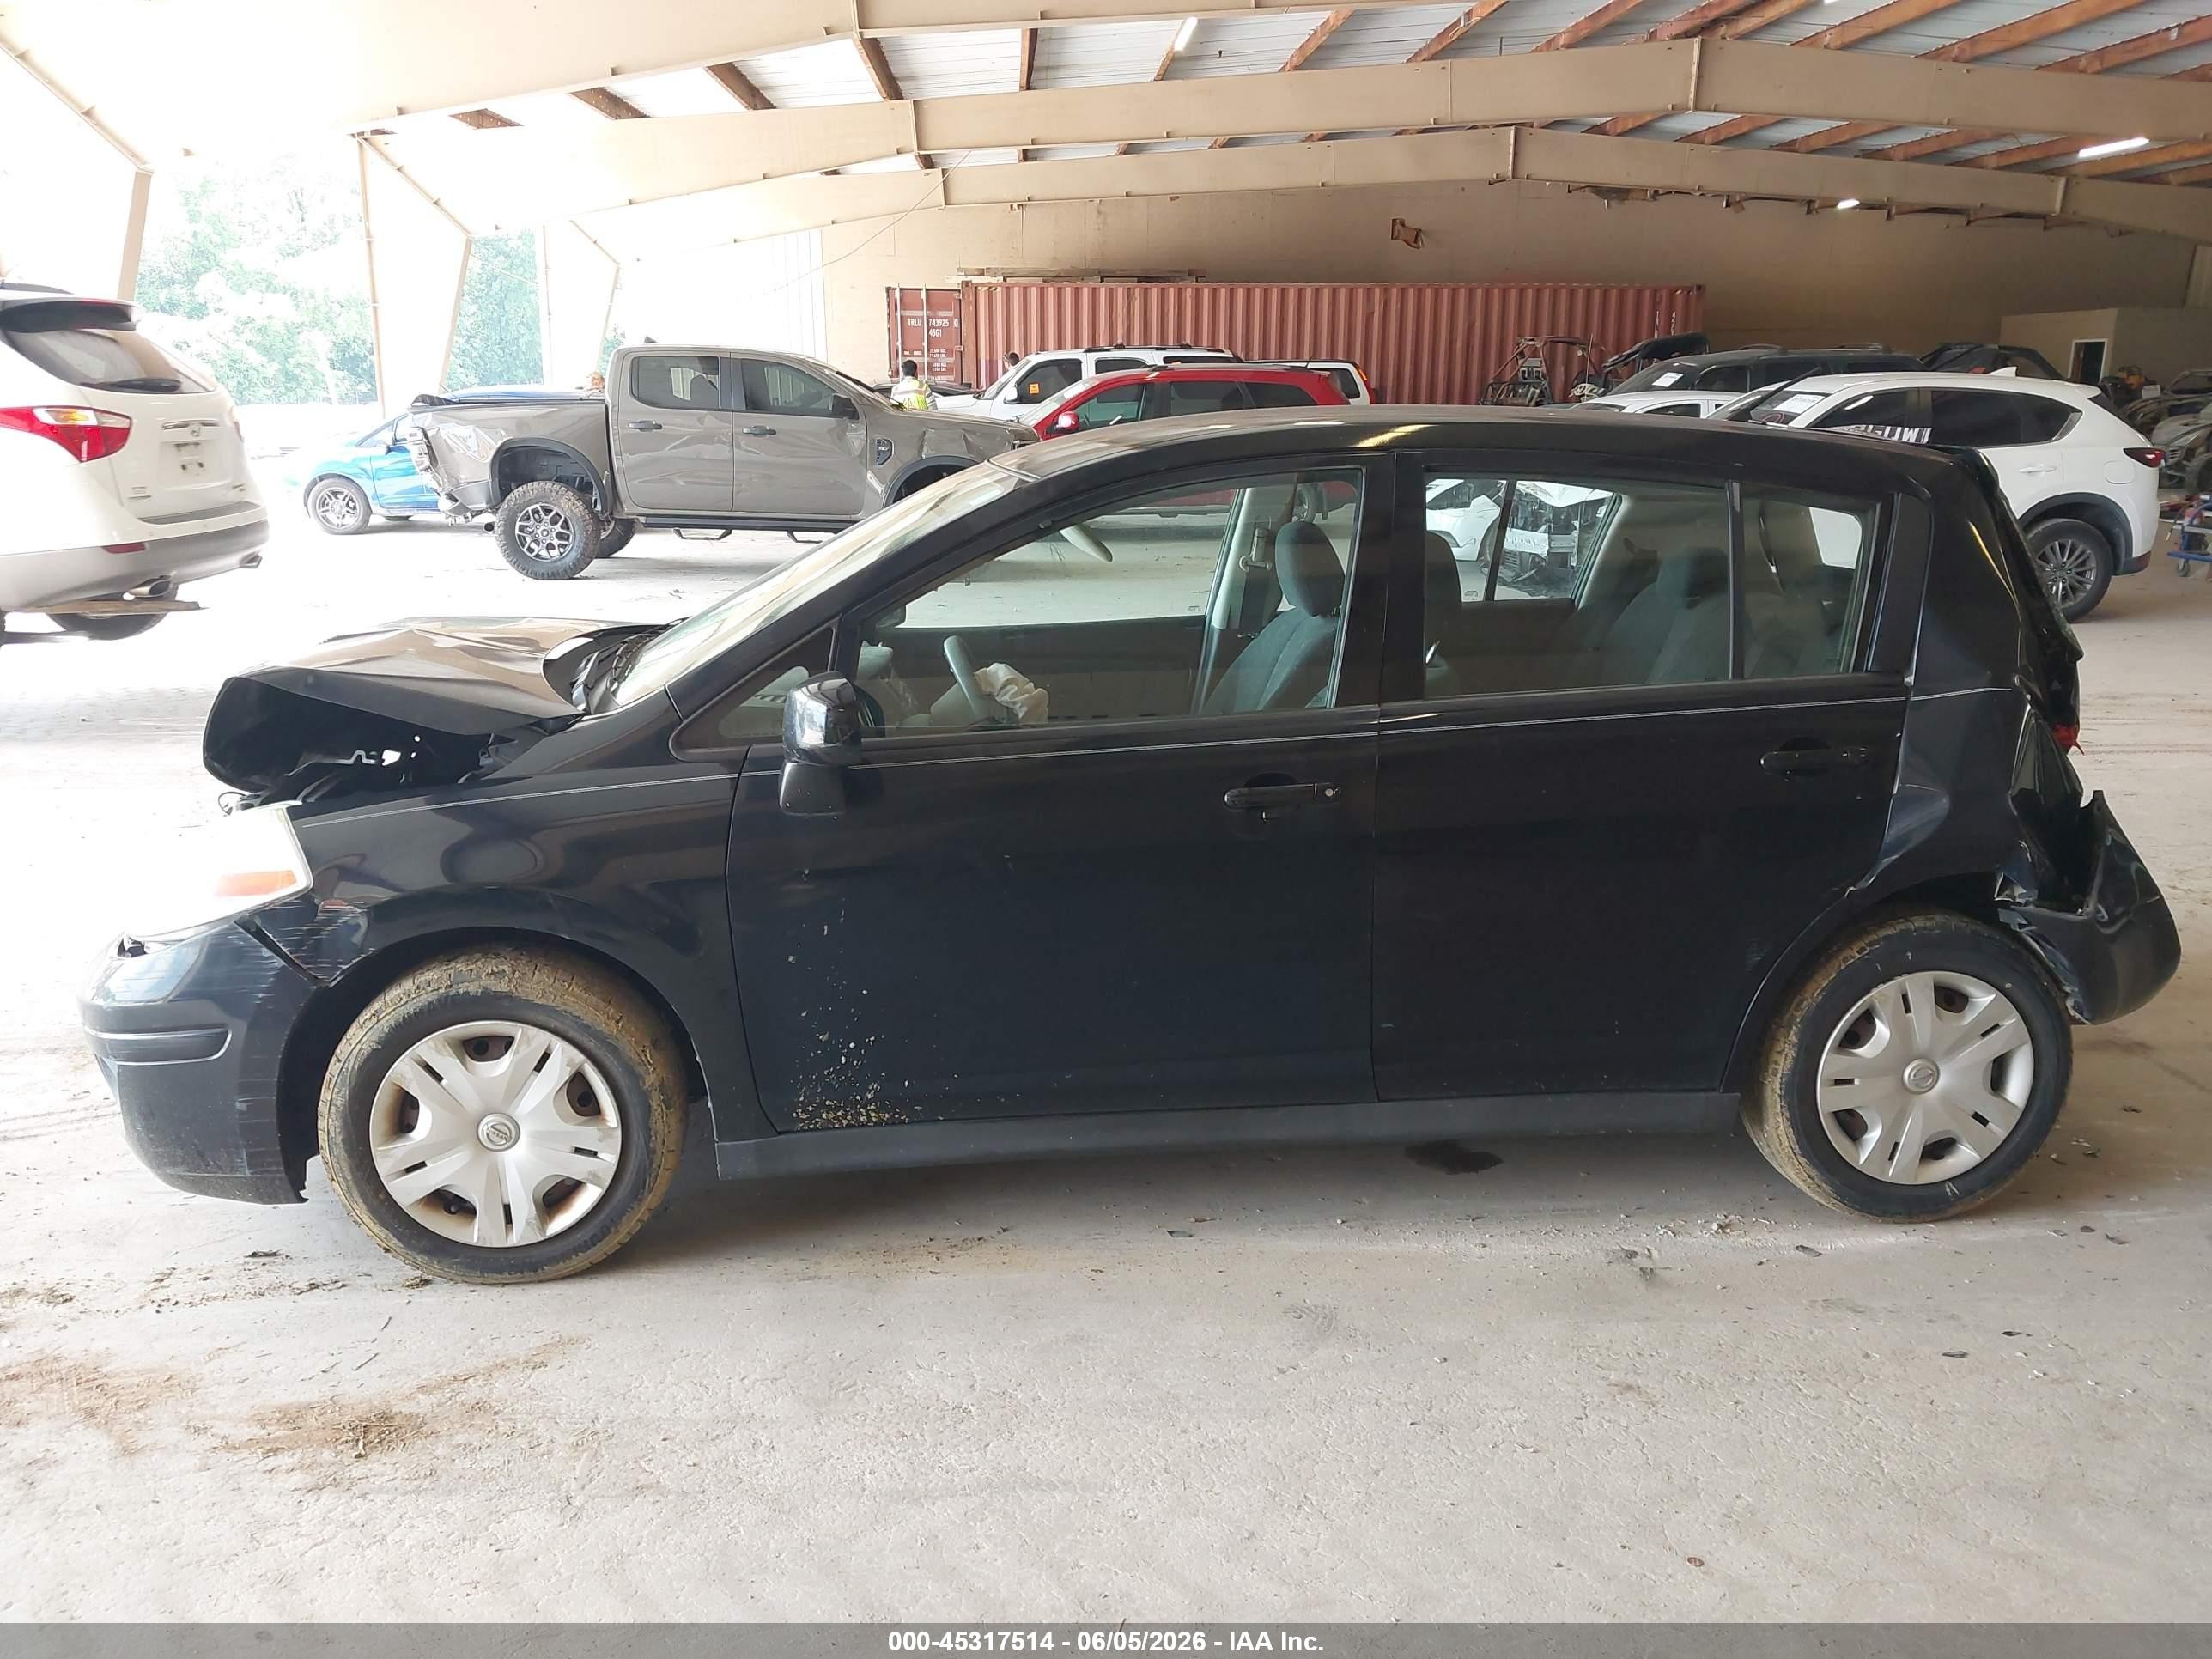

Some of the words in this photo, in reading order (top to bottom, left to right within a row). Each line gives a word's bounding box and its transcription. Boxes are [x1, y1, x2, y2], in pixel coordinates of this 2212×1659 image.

[907, 318, 922, 327] TRLU
[928, 318, 950, 327] 743925
[928, 328, 942, 337] 45G1
